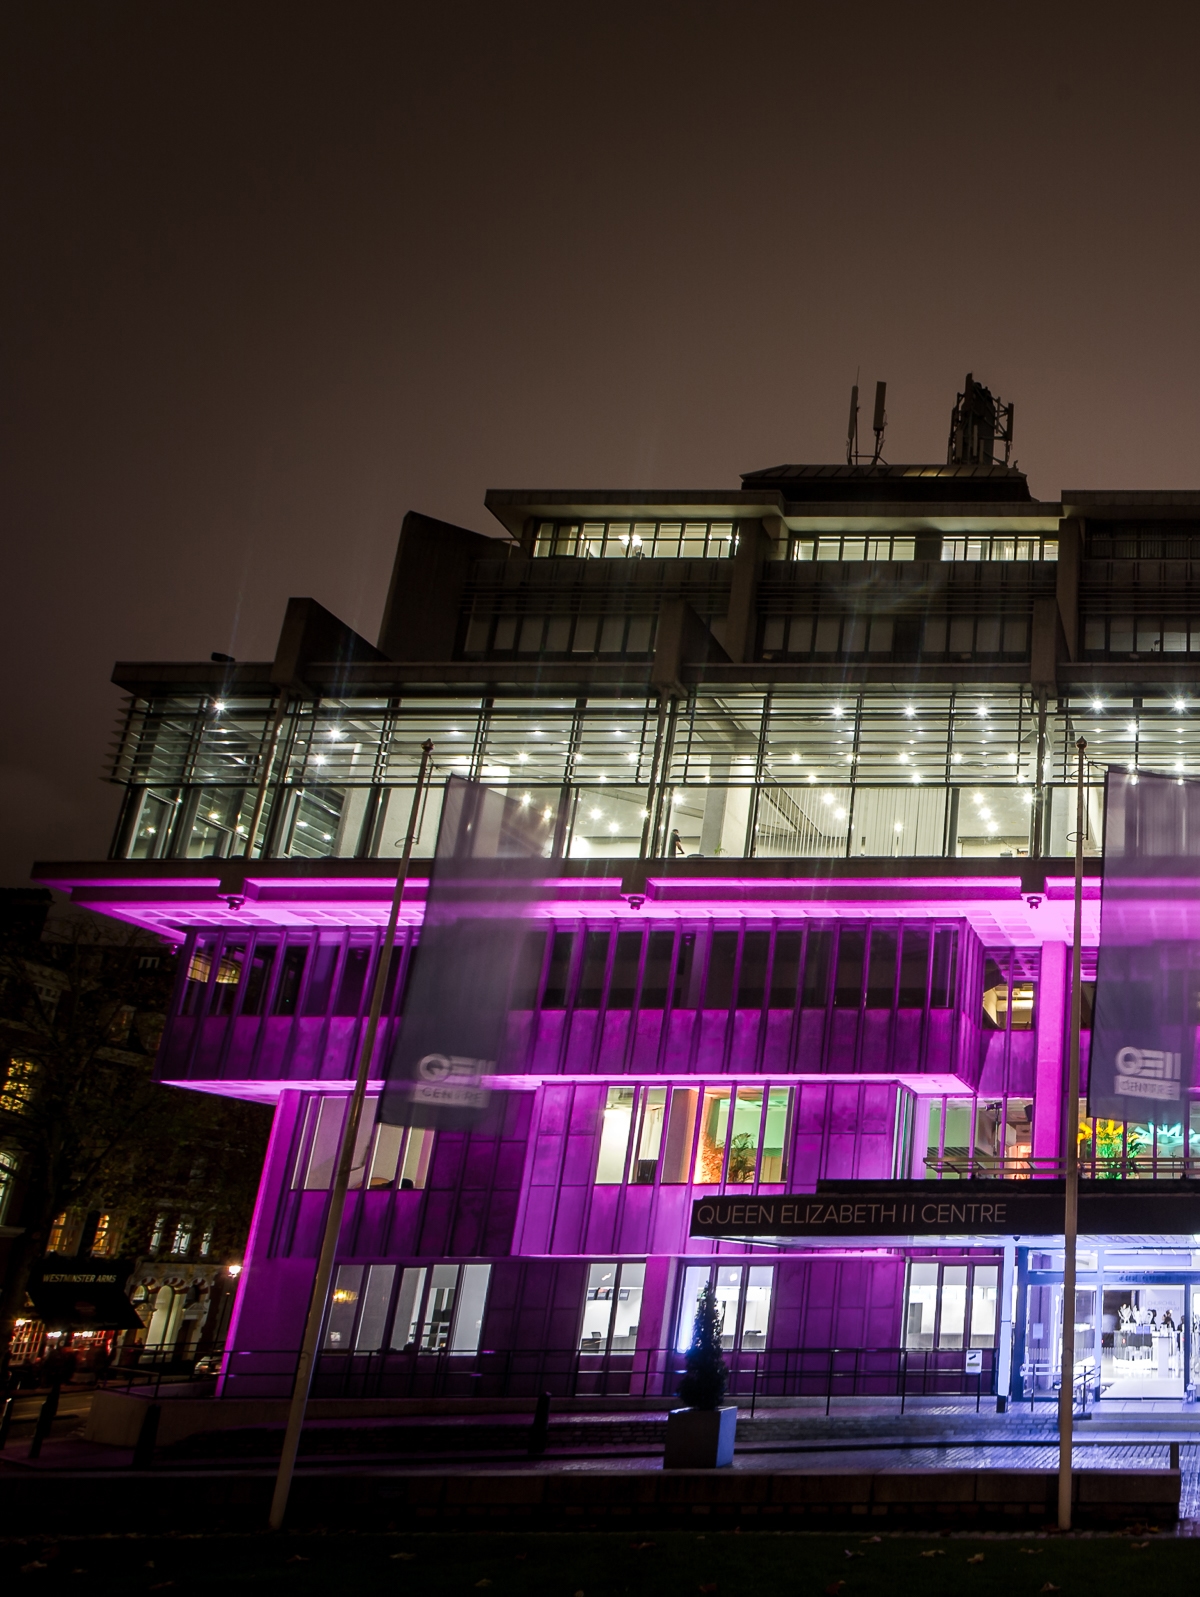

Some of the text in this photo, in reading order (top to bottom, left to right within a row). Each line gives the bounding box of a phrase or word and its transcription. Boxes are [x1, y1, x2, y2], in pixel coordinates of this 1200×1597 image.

[1115, 1046, 1182, 1080] QEII
[697, 1203, 1007, 1225] QUEEN ELIZABETH II CENTRE
[95, 1274, 118, 1284] ARMS
